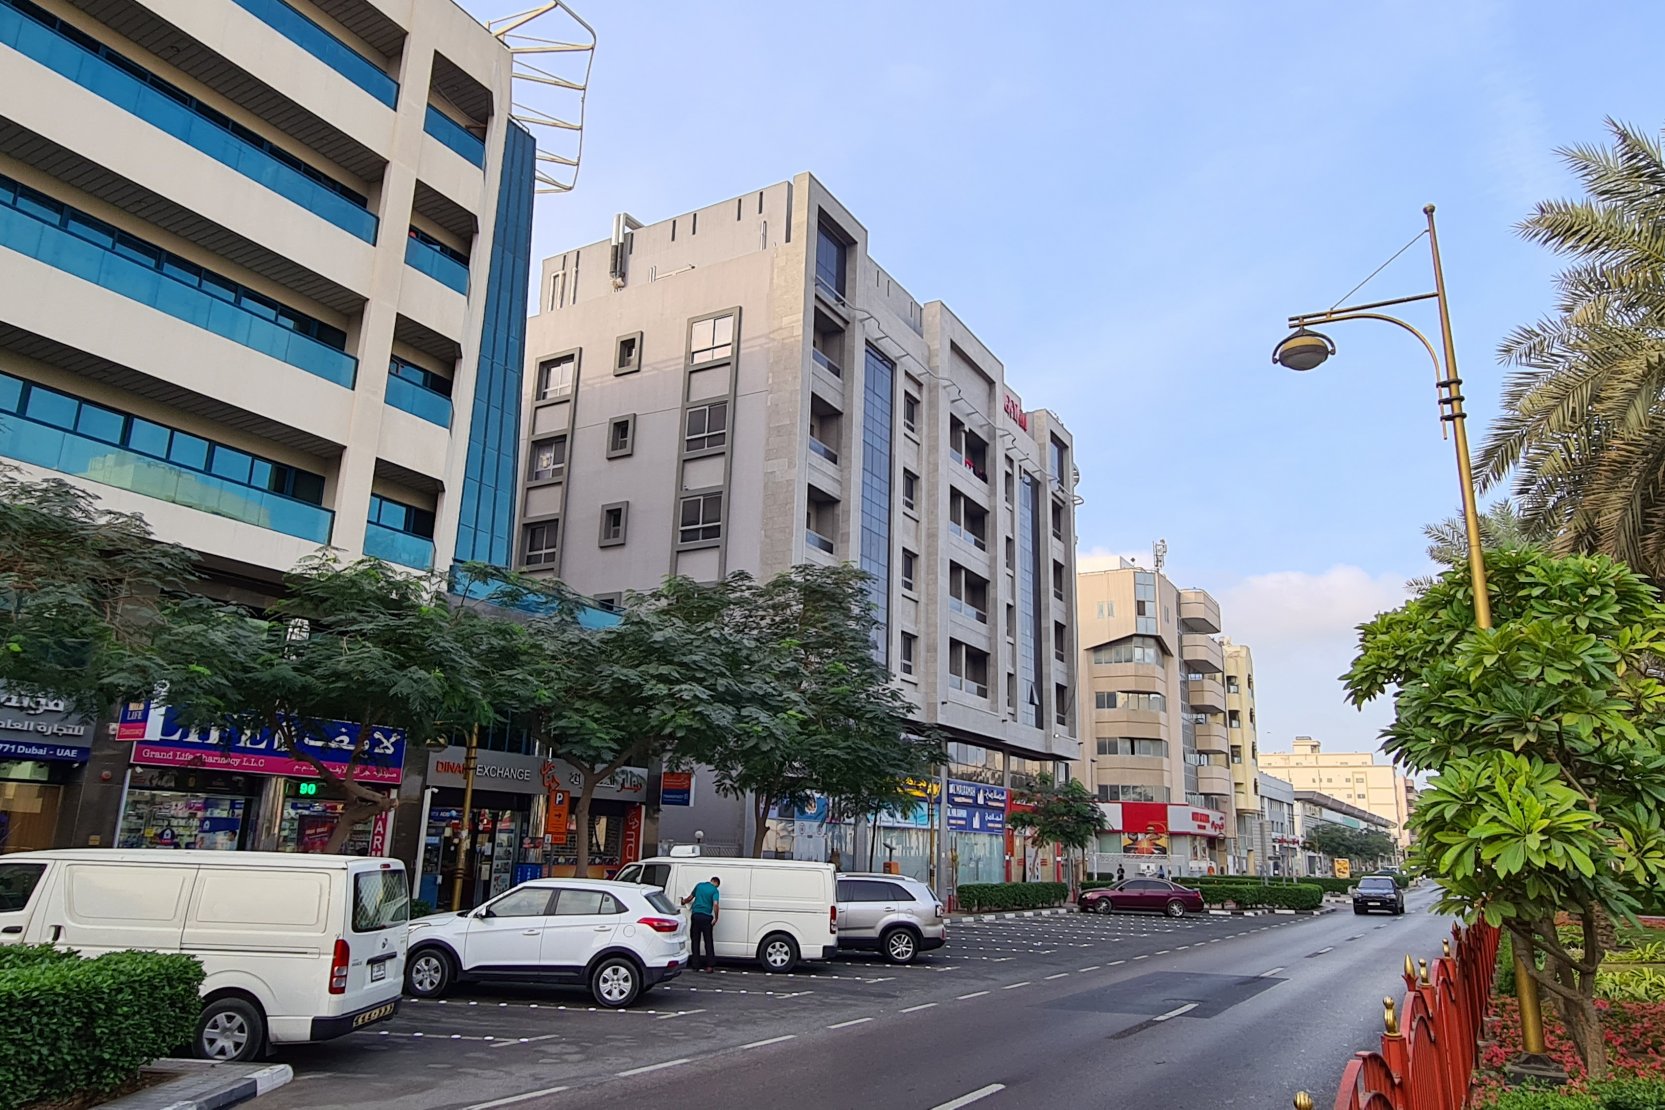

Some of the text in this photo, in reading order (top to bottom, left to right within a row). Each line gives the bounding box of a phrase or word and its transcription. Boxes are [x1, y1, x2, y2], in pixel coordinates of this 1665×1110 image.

[127, 711, 142, 720] LIFE
[37, 721, 85, 736] للتجارة
[17, 745, 47, 755] Dubai
[56, 748, 78, 758] UAE
[142, 749, 173, 760] Grand
[175, 751, 193, 761] Life
[476, 765, 532, 781] EXCHANGE
[555, 792, 564, 805] P
